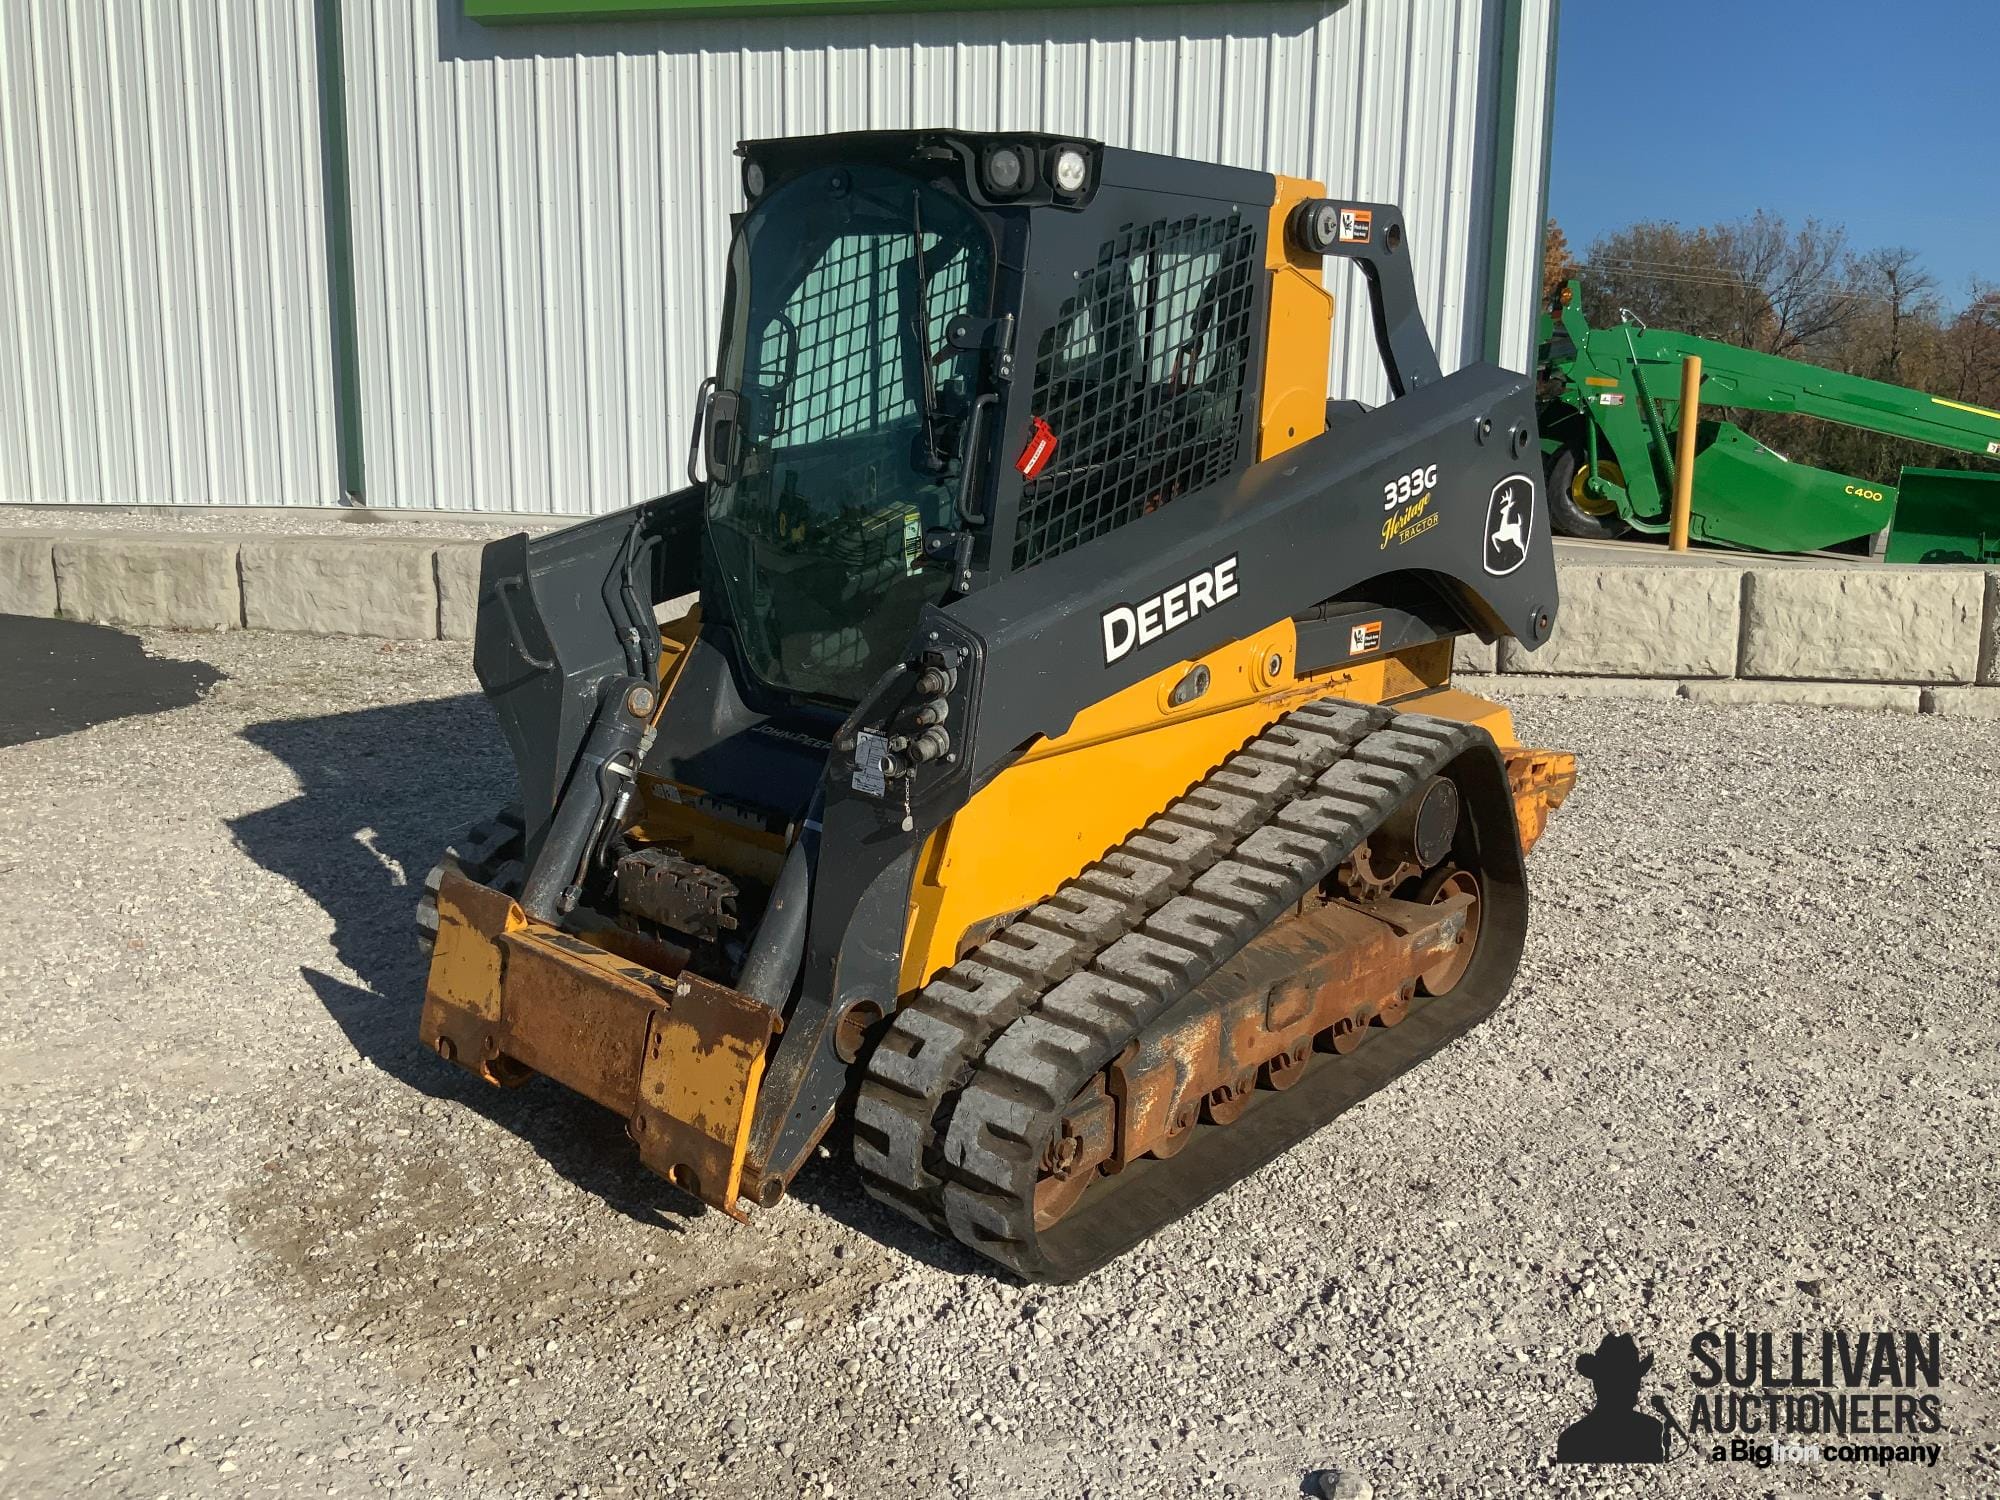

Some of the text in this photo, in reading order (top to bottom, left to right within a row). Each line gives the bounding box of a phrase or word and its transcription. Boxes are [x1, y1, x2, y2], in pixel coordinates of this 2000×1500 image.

[1384, 464, 1437, 511] 333G
[1380, 492, 1432, 550] Heritage
[1399, 514, 1439, 542] TRACTOR
[1102, 556, 1239, 664] DEERE
